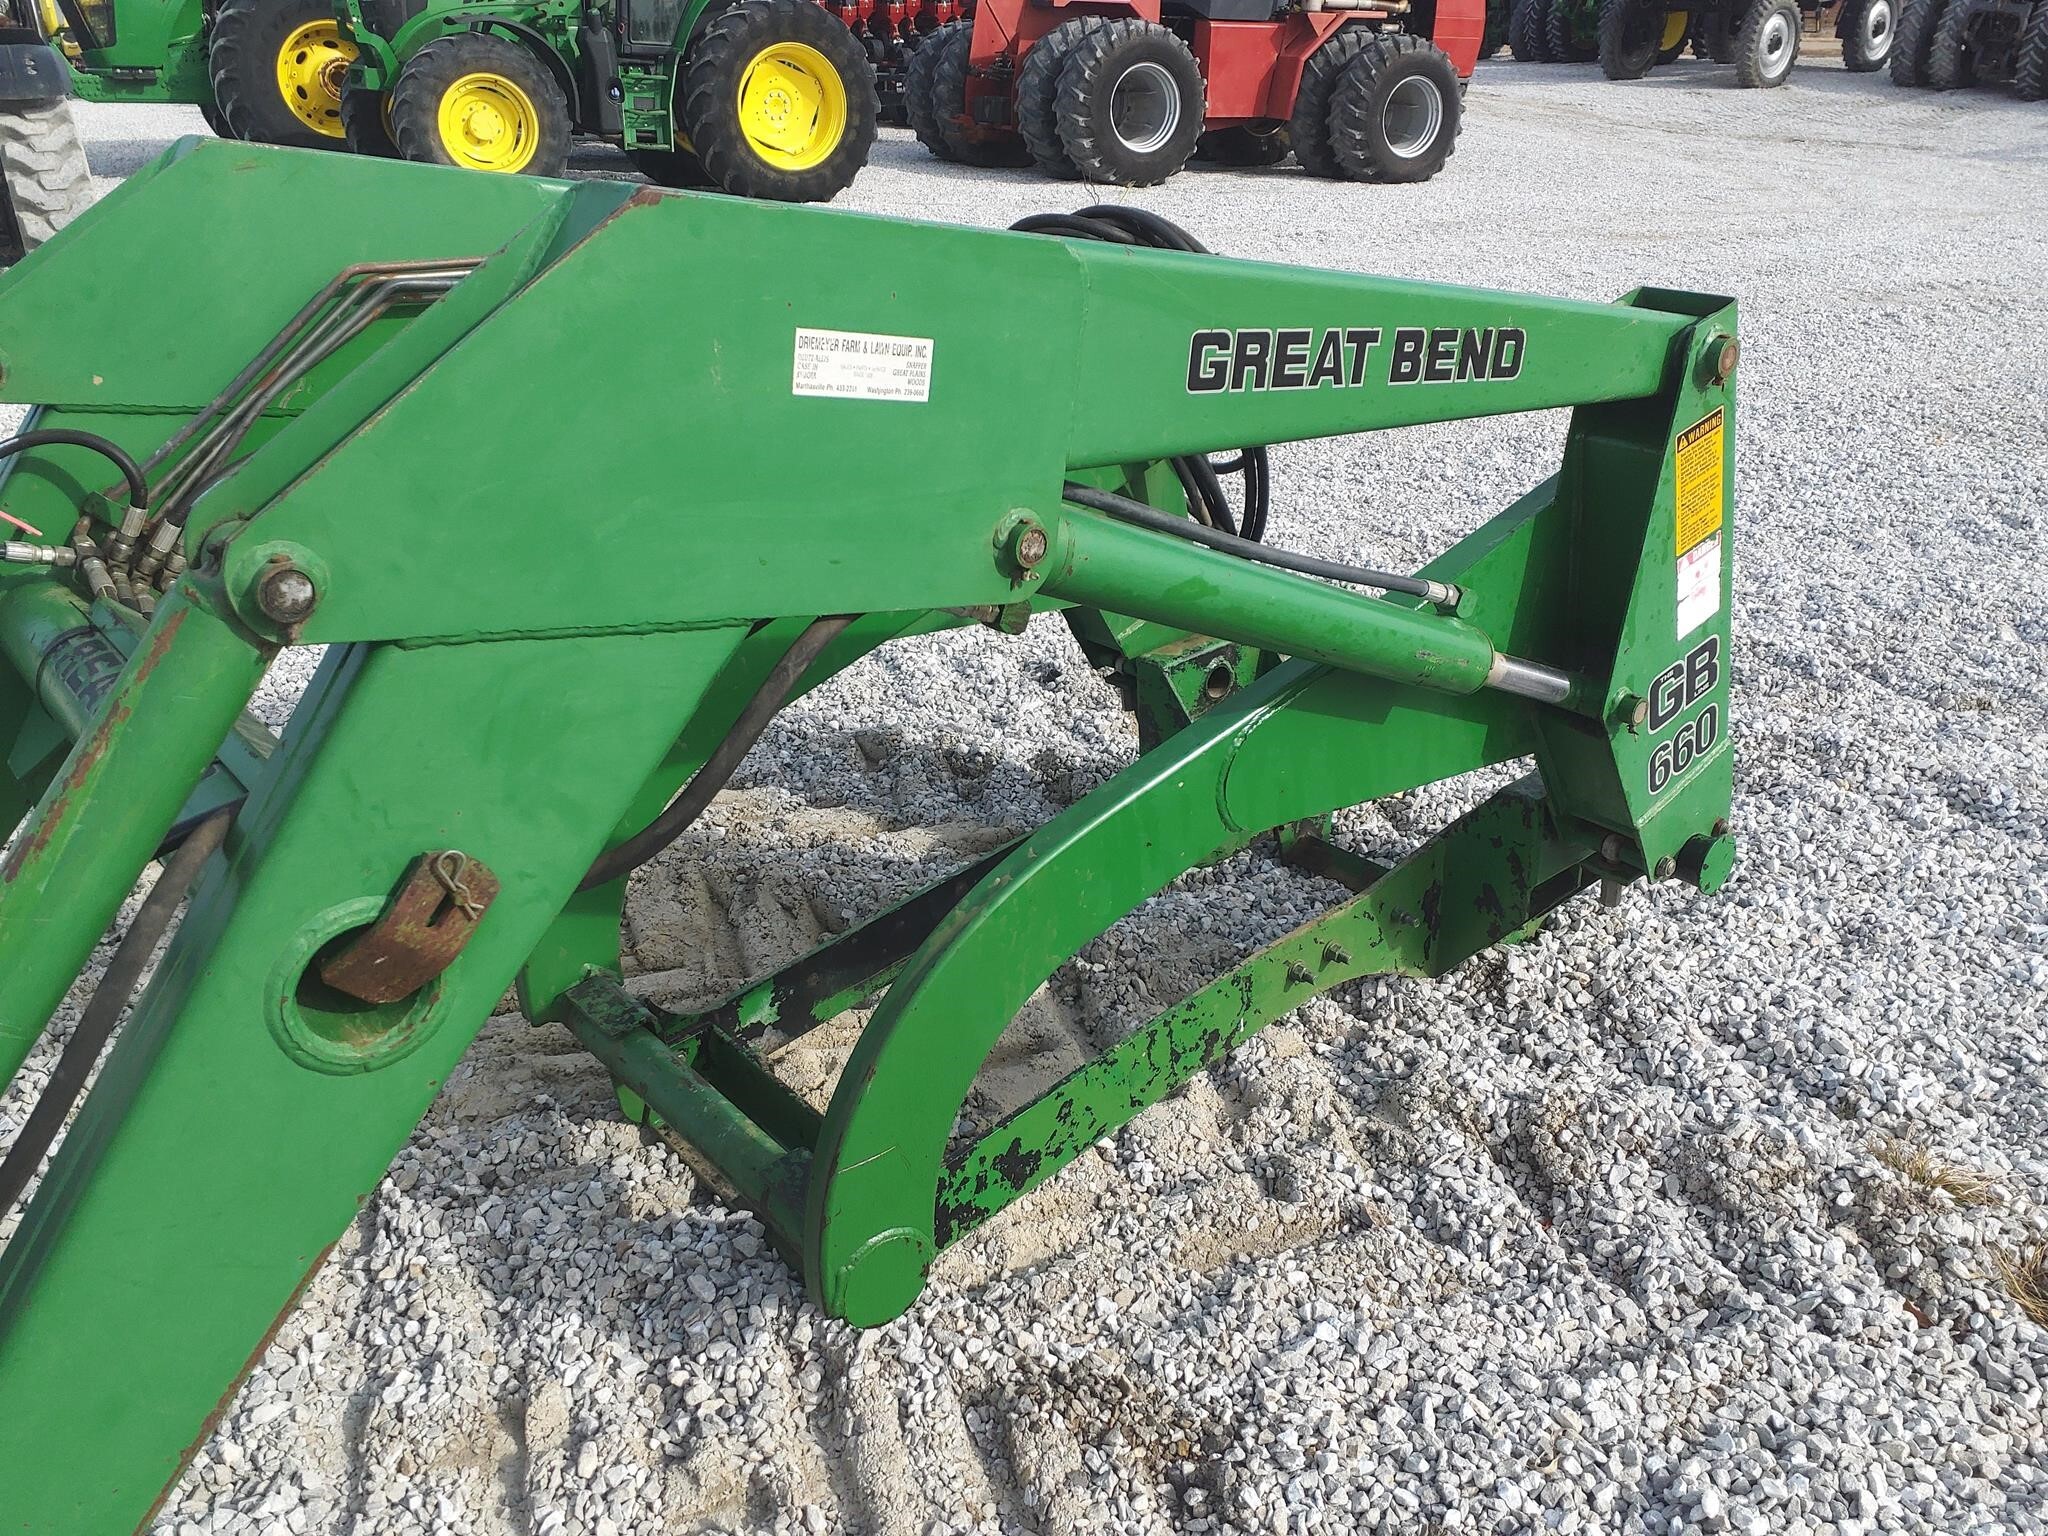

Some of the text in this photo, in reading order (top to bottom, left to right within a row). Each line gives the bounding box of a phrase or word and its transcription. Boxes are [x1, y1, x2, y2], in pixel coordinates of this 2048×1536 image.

[798, 335, 839, 352] DRIEMEYER
[841, 339, 861, 353] FARM
[862, 340, 868, 354] &
[870, 341, 890, 356] LAWN
[892, 343, 913, 358] EQUIP.
[1186, 326, 1526, 394] GREAT BEND
[1688, 413, 1722, 443] WARNING
[1647, 633, 1720, 735] GB
[1660, 669, 1674, 683] THE
[1648, 702, 1719, 796] 660
